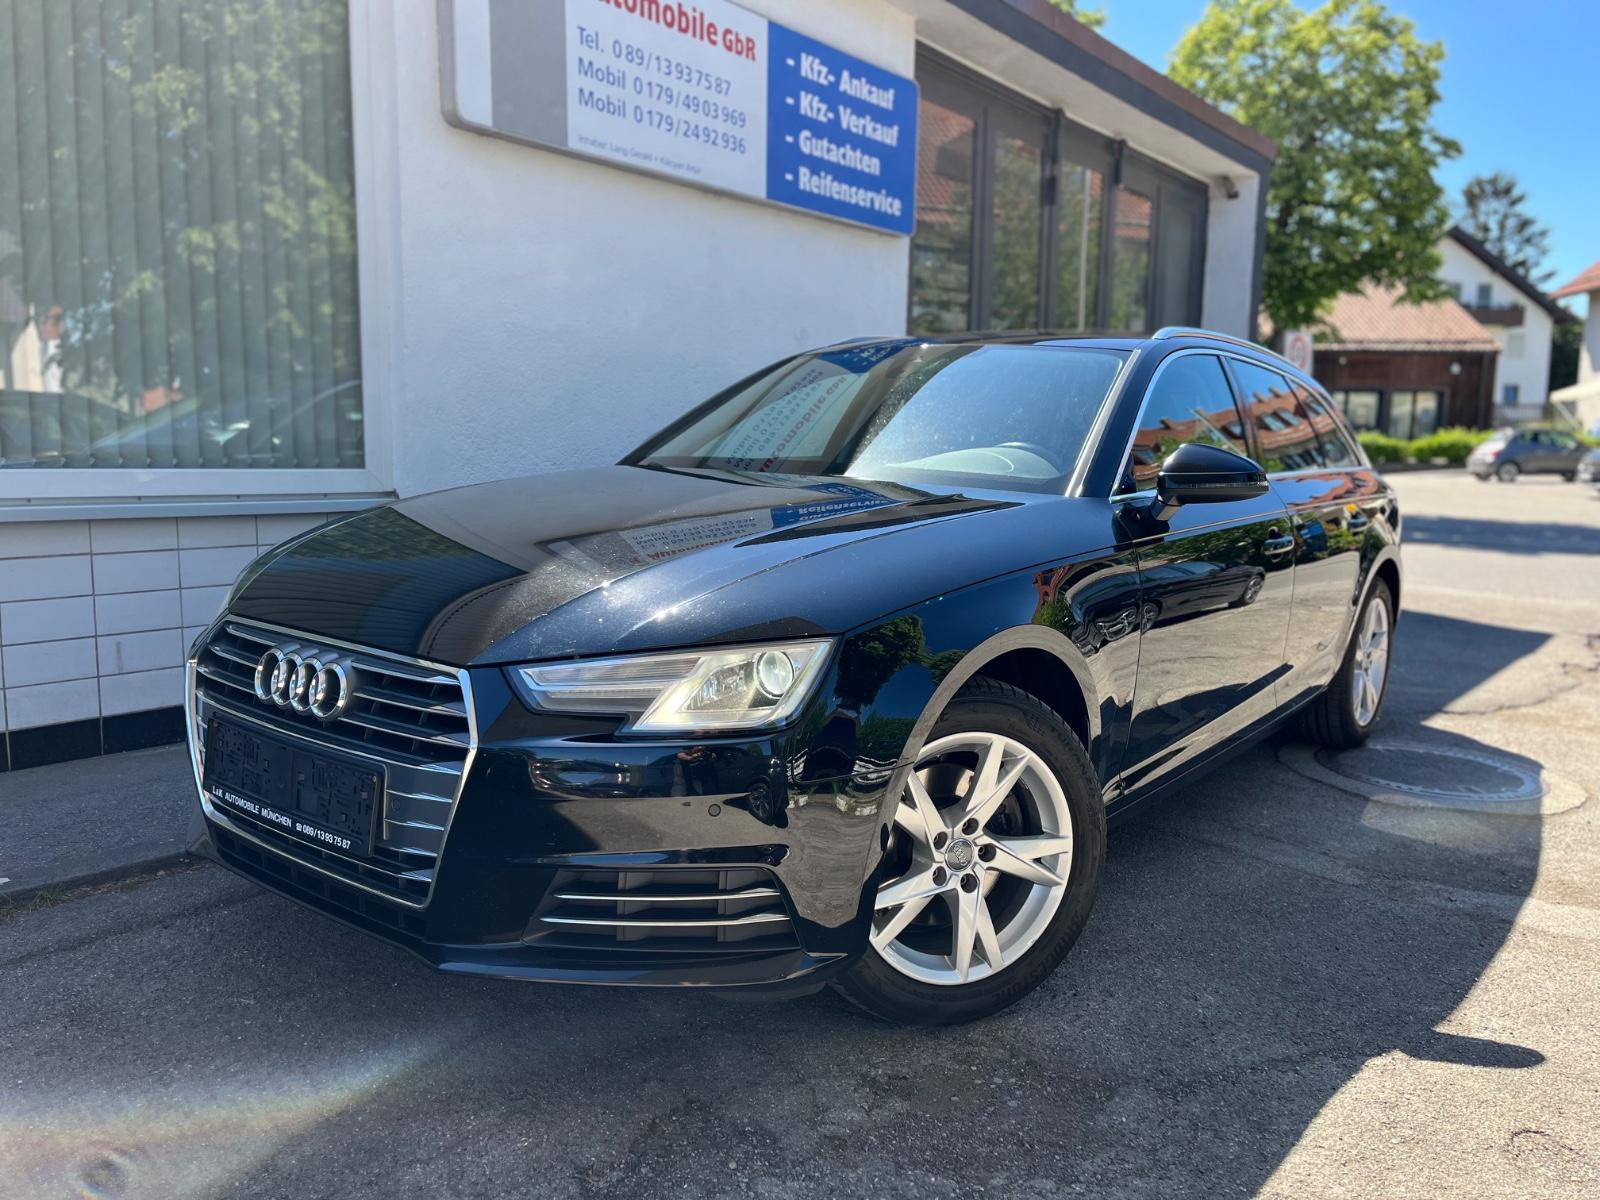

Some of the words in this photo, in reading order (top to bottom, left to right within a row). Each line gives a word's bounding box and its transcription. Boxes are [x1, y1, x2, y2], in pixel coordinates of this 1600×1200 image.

[577, 25, 604, 53] Tel.
[600, 0, 718, 46] omobile
[722, 28, 757, 62] GbR
[578, 57, 626, 89] Mobil
[801, 52, 835, 86] Kfz-
[839, 69, 895, 111] Ankauf
[578, 87, 626, 119] Mobil
[800, 91, 835, 123] Kfz-
[838, 105, 899, 147] Verkauf
[799, 129, 881, 176] Gutachten
[798, 166, 903, 217] Reifenservice
[225, 792, 260, 815] AUTOMOBILE
[261, 808, 292, 828] MÜNCHEN
